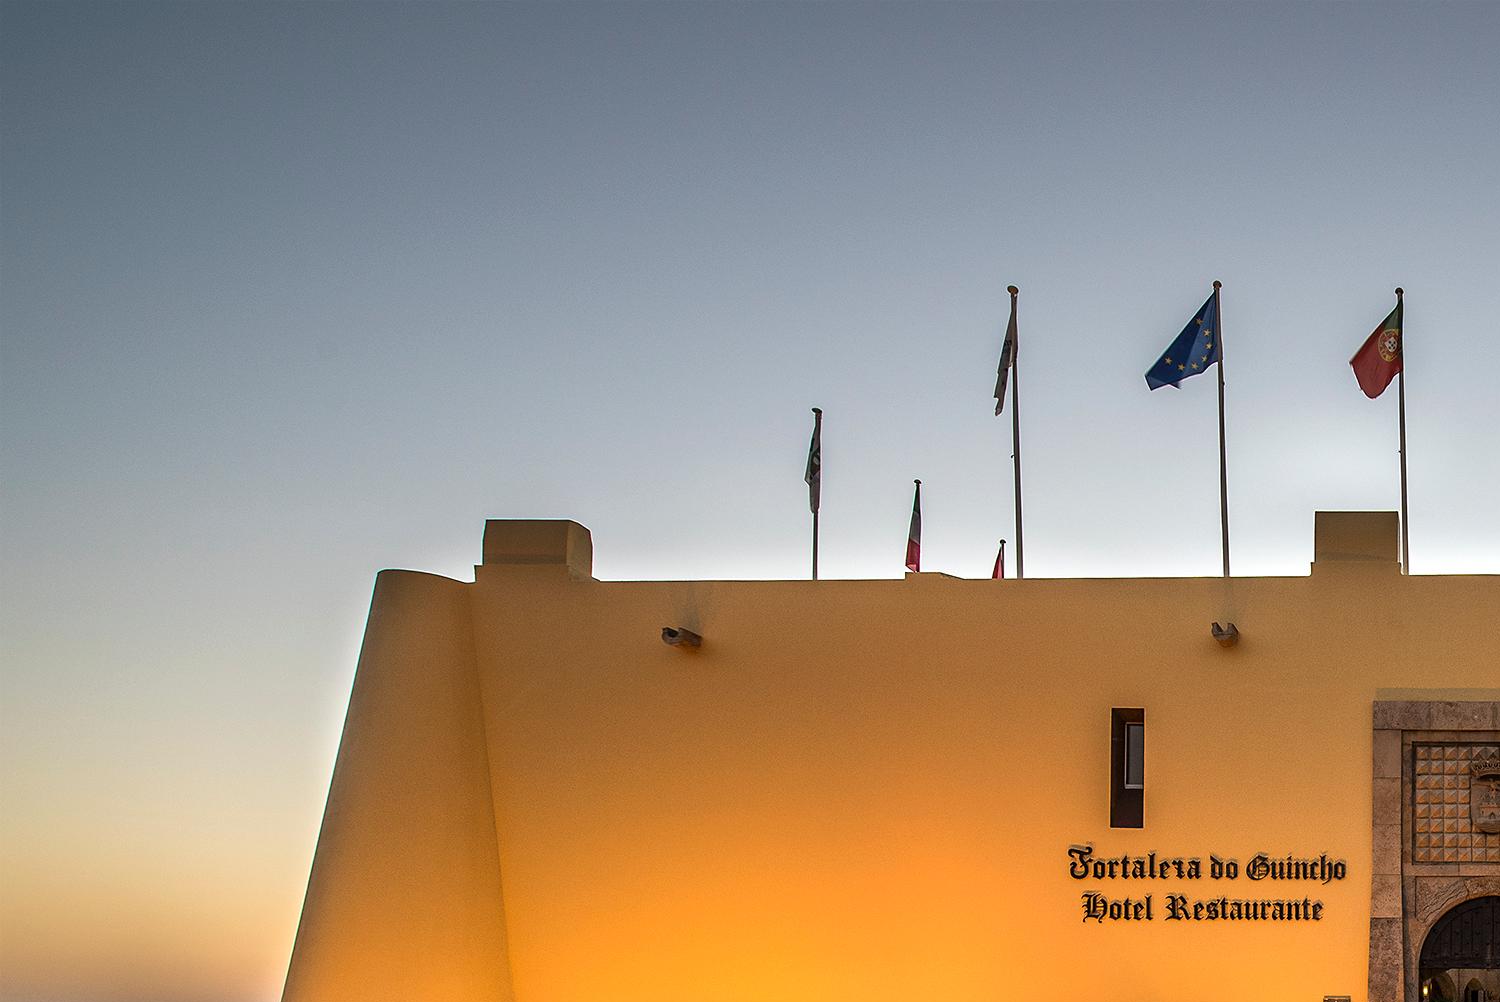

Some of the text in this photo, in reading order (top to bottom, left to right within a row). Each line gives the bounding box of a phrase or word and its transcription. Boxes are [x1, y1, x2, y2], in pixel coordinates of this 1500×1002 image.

[1068, 845, 1346, 885] Fortaleza do Guincho
[1081, 892, 1325, 923] Hotel Restaurante
